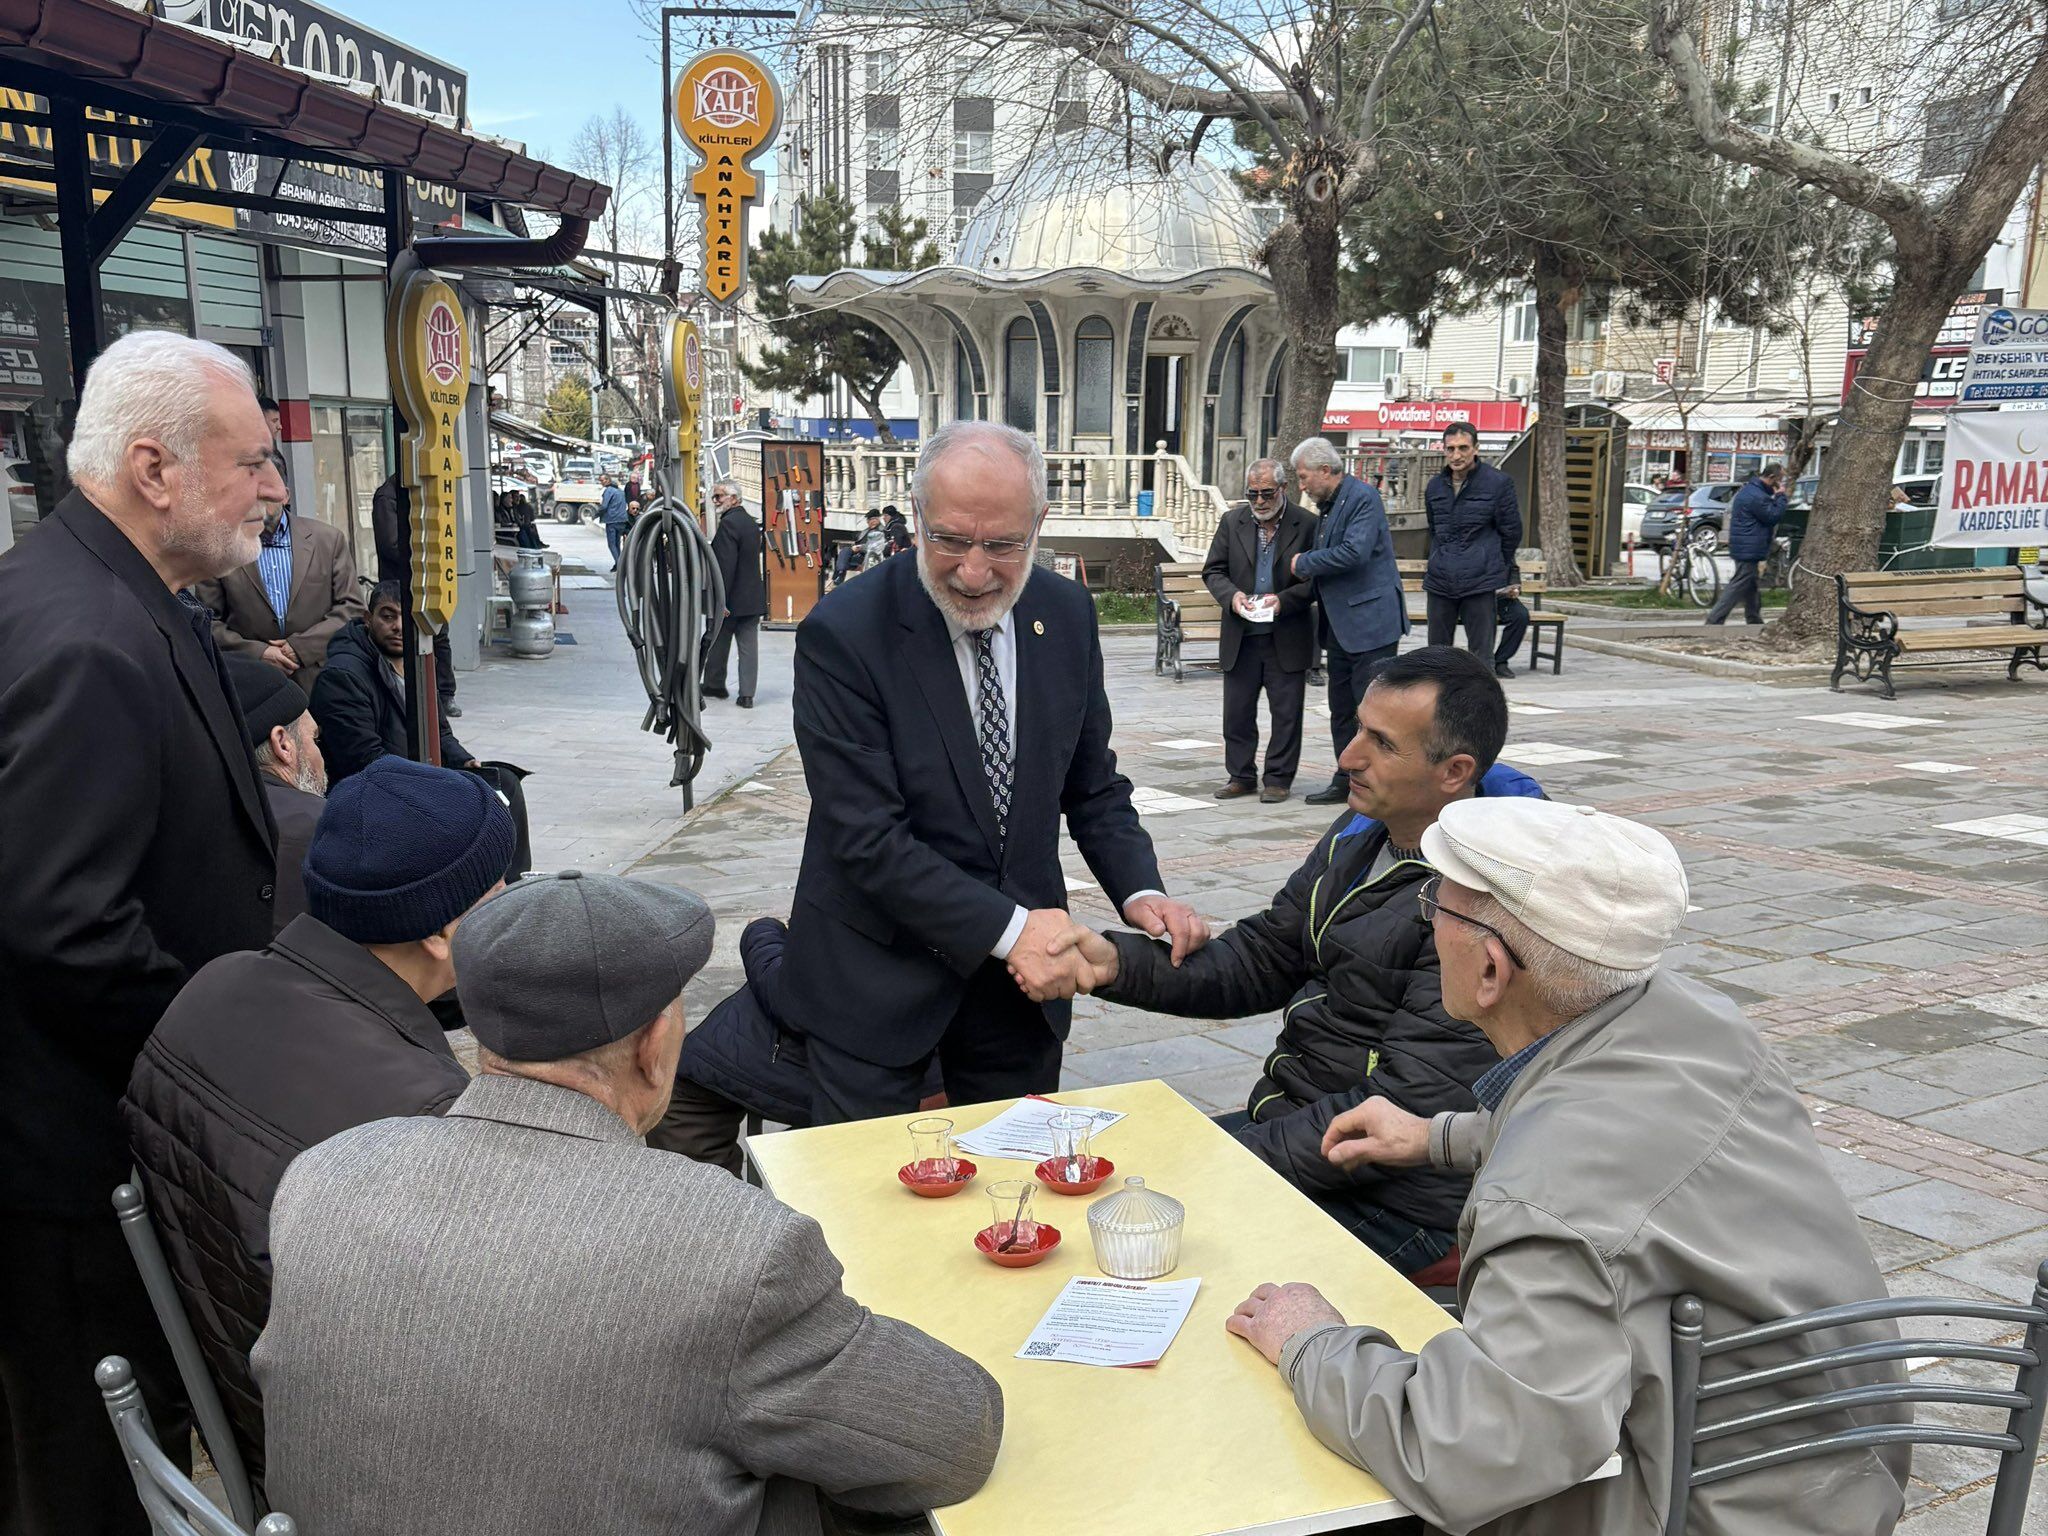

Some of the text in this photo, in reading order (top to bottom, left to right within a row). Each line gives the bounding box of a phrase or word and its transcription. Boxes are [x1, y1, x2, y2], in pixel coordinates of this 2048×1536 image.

[696, 83, 757, 120] KALE
[699, 134, 752, 146] KİLİTLERİ
[717, 155, 734, 292] ANAHTARCI
[427, 326, 462, 372] KALE
[1976, 352, 2032, 365] BEYŞEHİR
[1390, 406, 1431, 422] vodafone
[442, 412, 454, 604] ANAHTARCI
[1959, 507, 2041, 532] KARDEŞLİĞE
